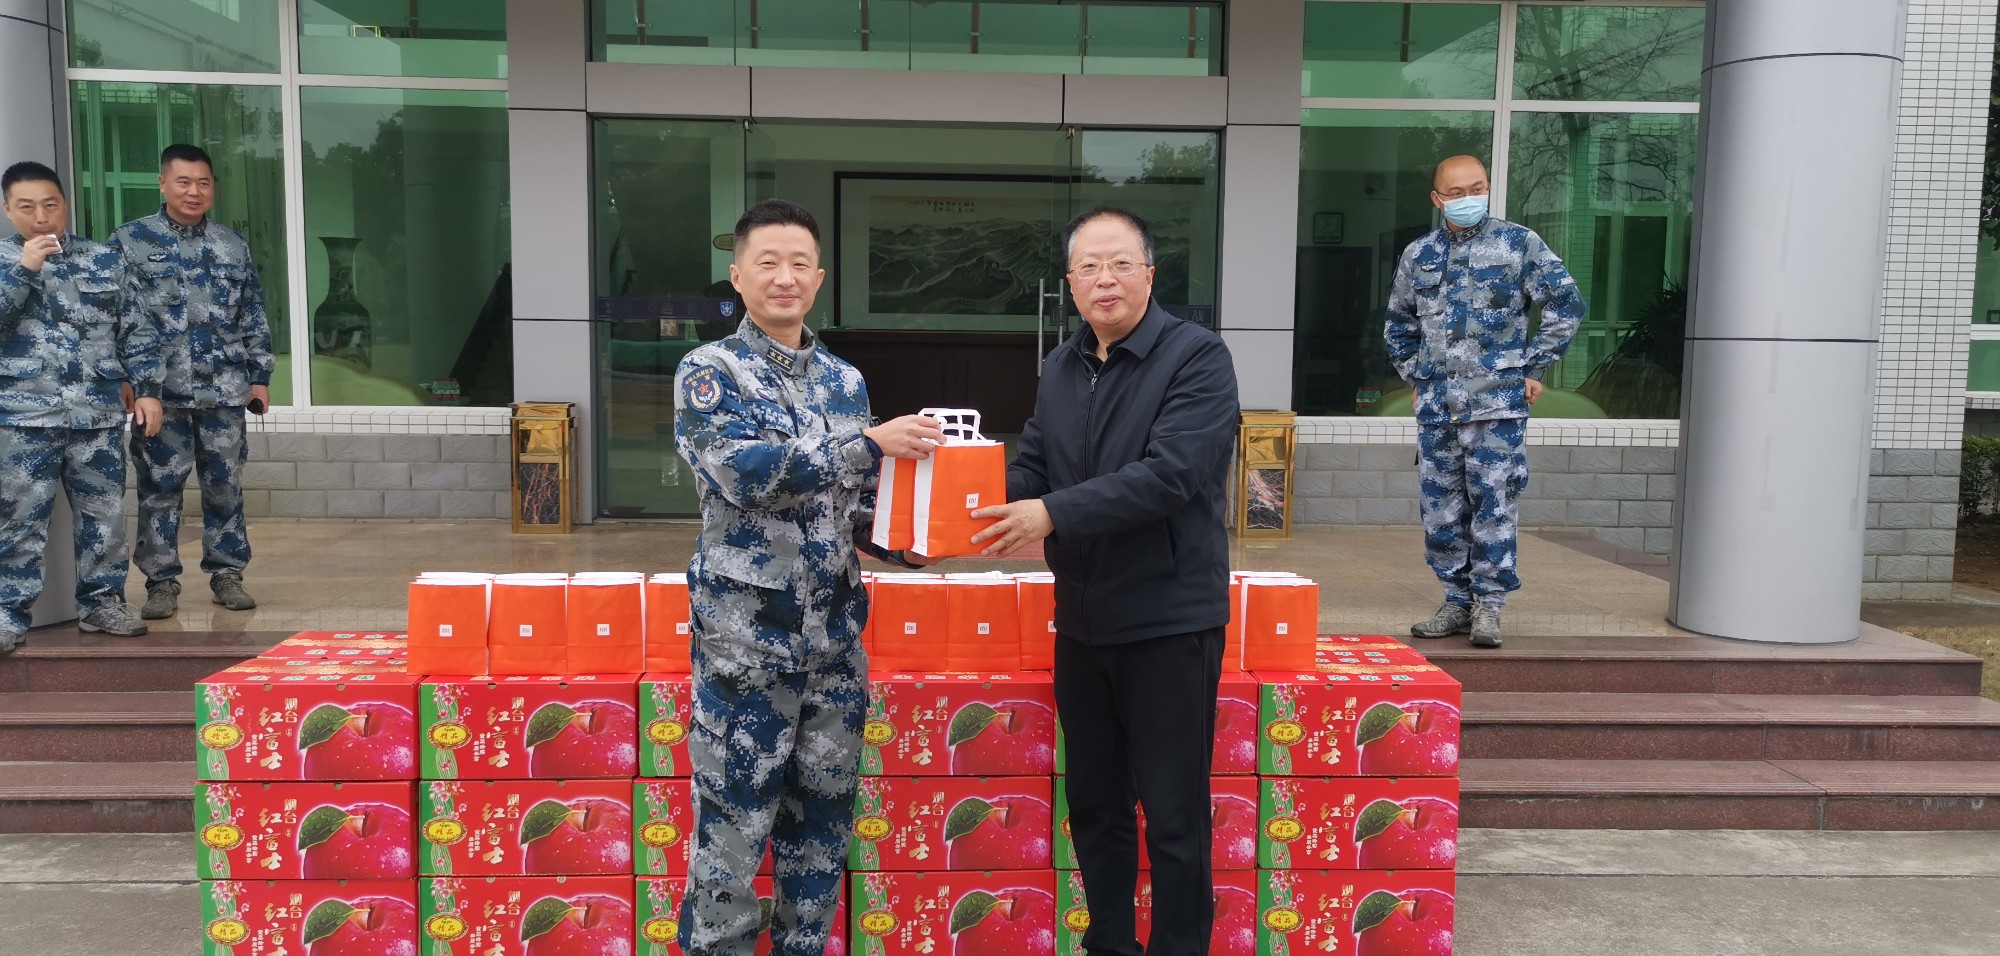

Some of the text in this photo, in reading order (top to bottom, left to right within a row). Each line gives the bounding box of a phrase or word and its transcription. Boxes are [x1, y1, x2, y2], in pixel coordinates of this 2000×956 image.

[259, 707, 283, 770] 红富士
[487, 706, 511, 768] 红富士
[912, 705, 934, 765] 红富士
[1320, 706, 1343, 765] 红富士
[259, 808, 283, 870] 红富士
[482, 803, 505, 864] 红富士
[908, 800, 930, 860] 红富士
[1319, 803, 1341, 861] 红富士
[913, 895, 936, 954] 红富士
[1318, 893, 1340, 952] 红富士
